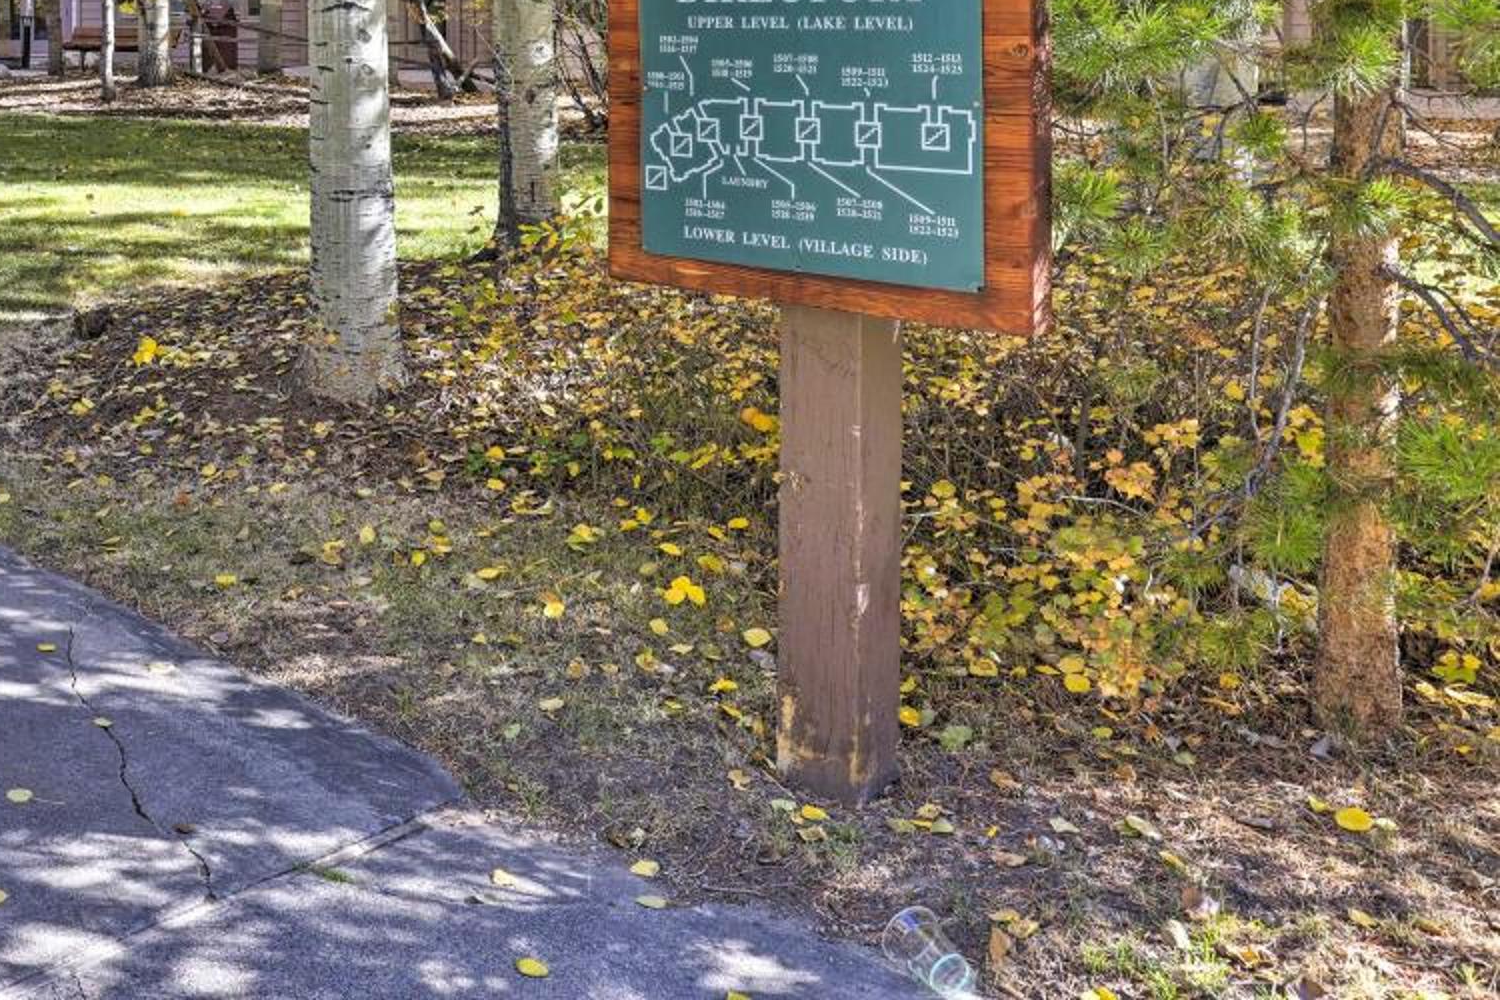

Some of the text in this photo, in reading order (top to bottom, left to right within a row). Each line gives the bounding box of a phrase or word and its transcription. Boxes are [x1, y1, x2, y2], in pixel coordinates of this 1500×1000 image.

[687, 15, 914, 31] UPPER LEVEL (LAKE LEVEL)
[683, 225, 928, 265] LOWER LEVEL (VILLAGE SIDE)
